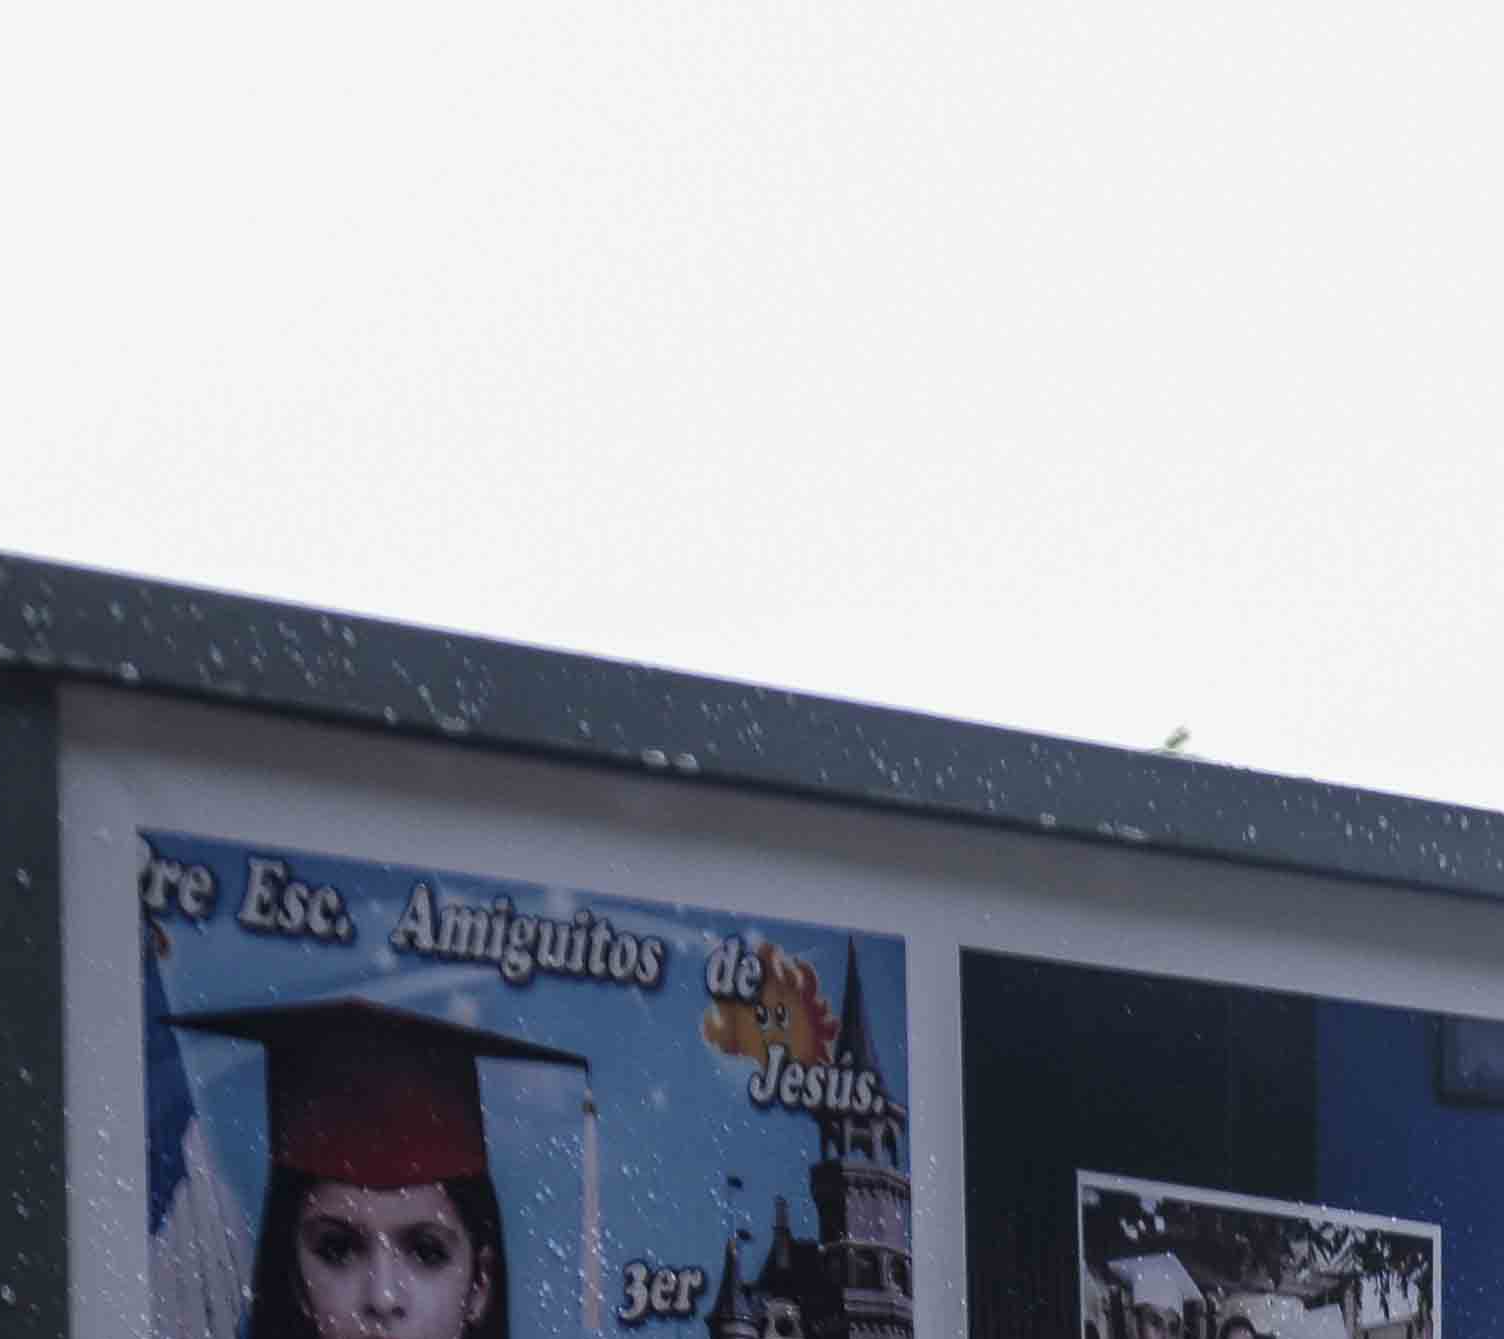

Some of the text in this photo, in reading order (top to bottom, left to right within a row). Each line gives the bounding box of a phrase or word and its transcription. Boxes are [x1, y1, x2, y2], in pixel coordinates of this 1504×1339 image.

[138, 838, 761, 998] re Esc. Amiguitos de
[749, 1045, 884, 1113] Jesús.
[622, 1262, 702, 1321] 3er
